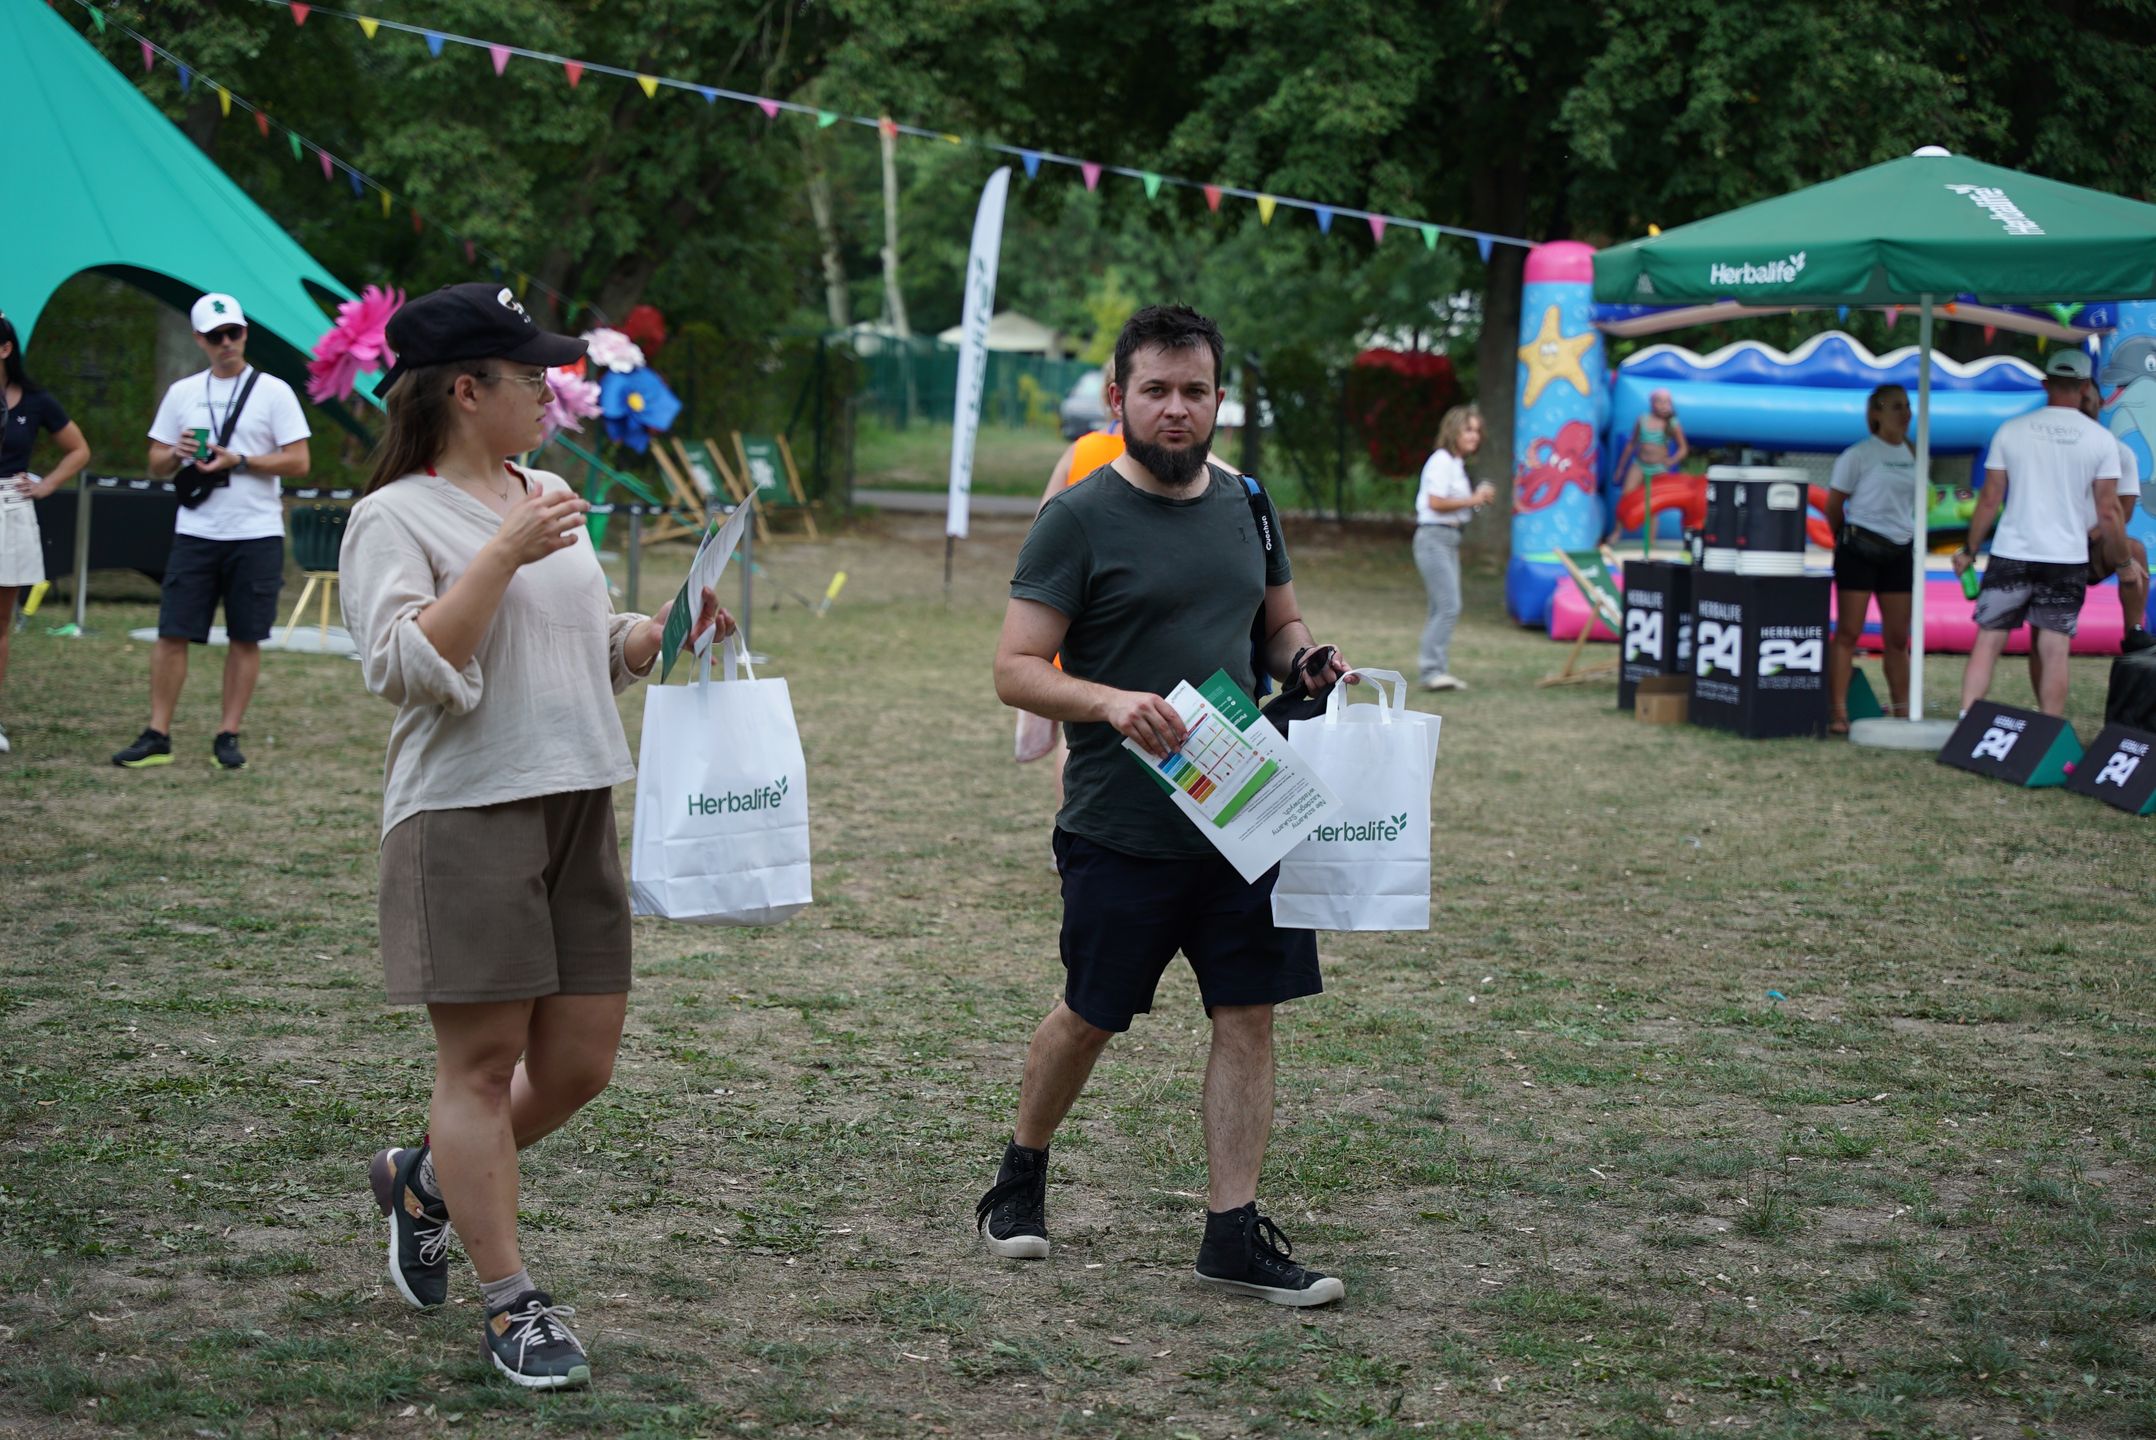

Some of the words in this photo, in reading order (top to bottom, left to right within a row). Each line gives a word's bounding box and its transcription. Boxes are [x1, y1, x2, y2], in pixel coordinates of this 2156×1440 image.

[1710, 260, 1797, 285] Herbalife
[1627, 590, 1663, 609] HERBALIFE
[1699, 600, 1743, 623] HERBALIFE
[1625, 609, 1663, 661] 24
[1760, 626, 1823, 639] HERBALIFE
[1696, 620, 1742, 678] 24
[1758, 638, 1824, 676] 24
[1971, 727, 2019, 762] 24
[2095, 752, 2140, 787] 24
[688, 786, 781, 816] Herbalife
